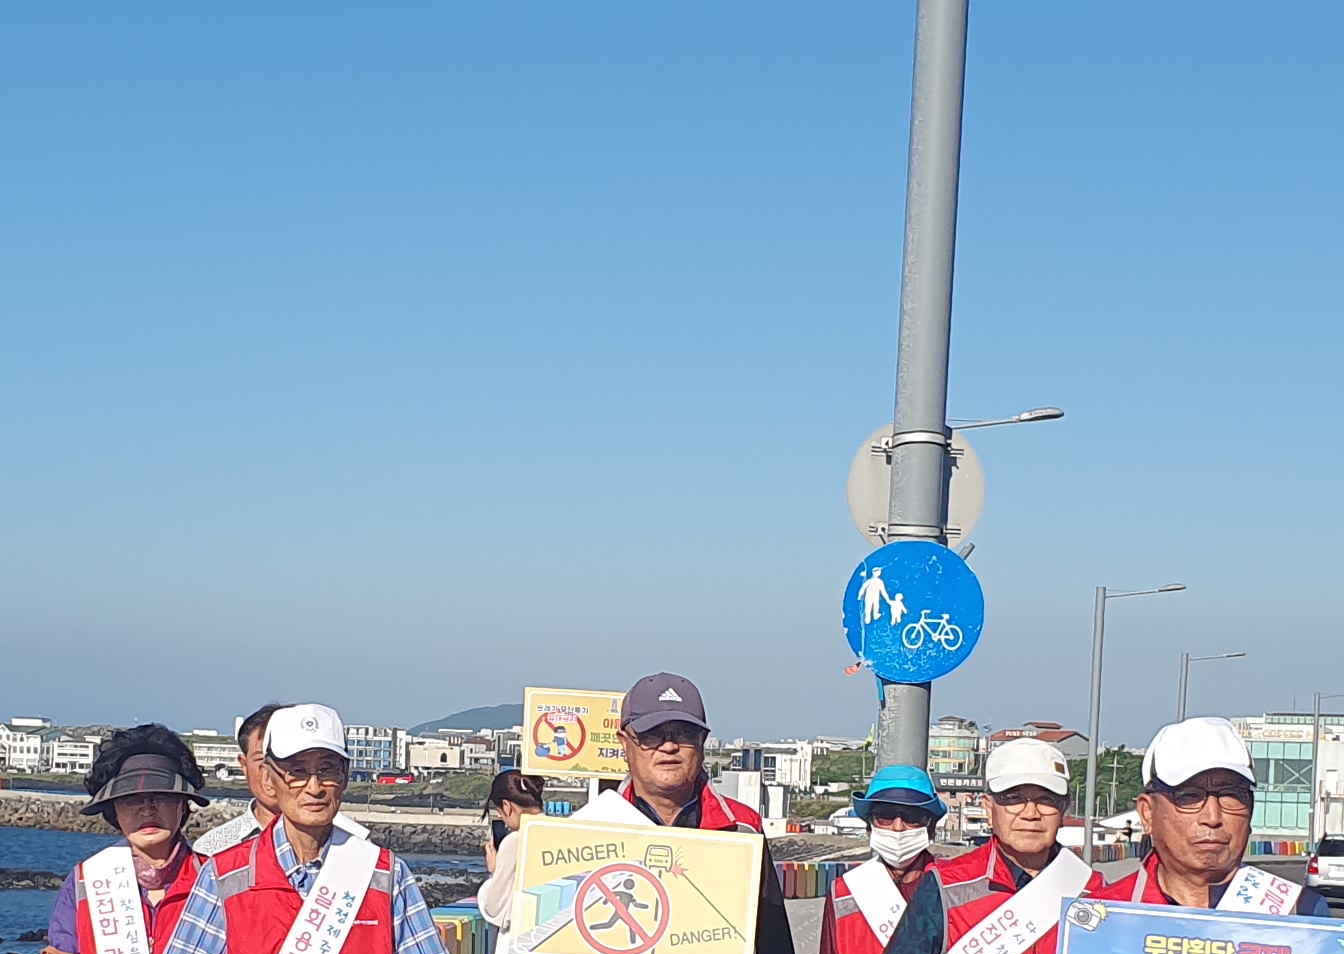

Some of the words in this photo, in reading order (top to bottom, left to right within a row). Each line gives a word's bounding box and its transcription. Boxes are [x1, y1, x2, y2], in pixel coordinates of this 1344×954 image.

[541, 841, 626, 867] DANGER!
[113, 864, 130, 891] 다시
[92, 878, 119, 937] 안전한
[670, 926, 738, 946] DANGER!
[1013, 920, 1036, 946] 다시
